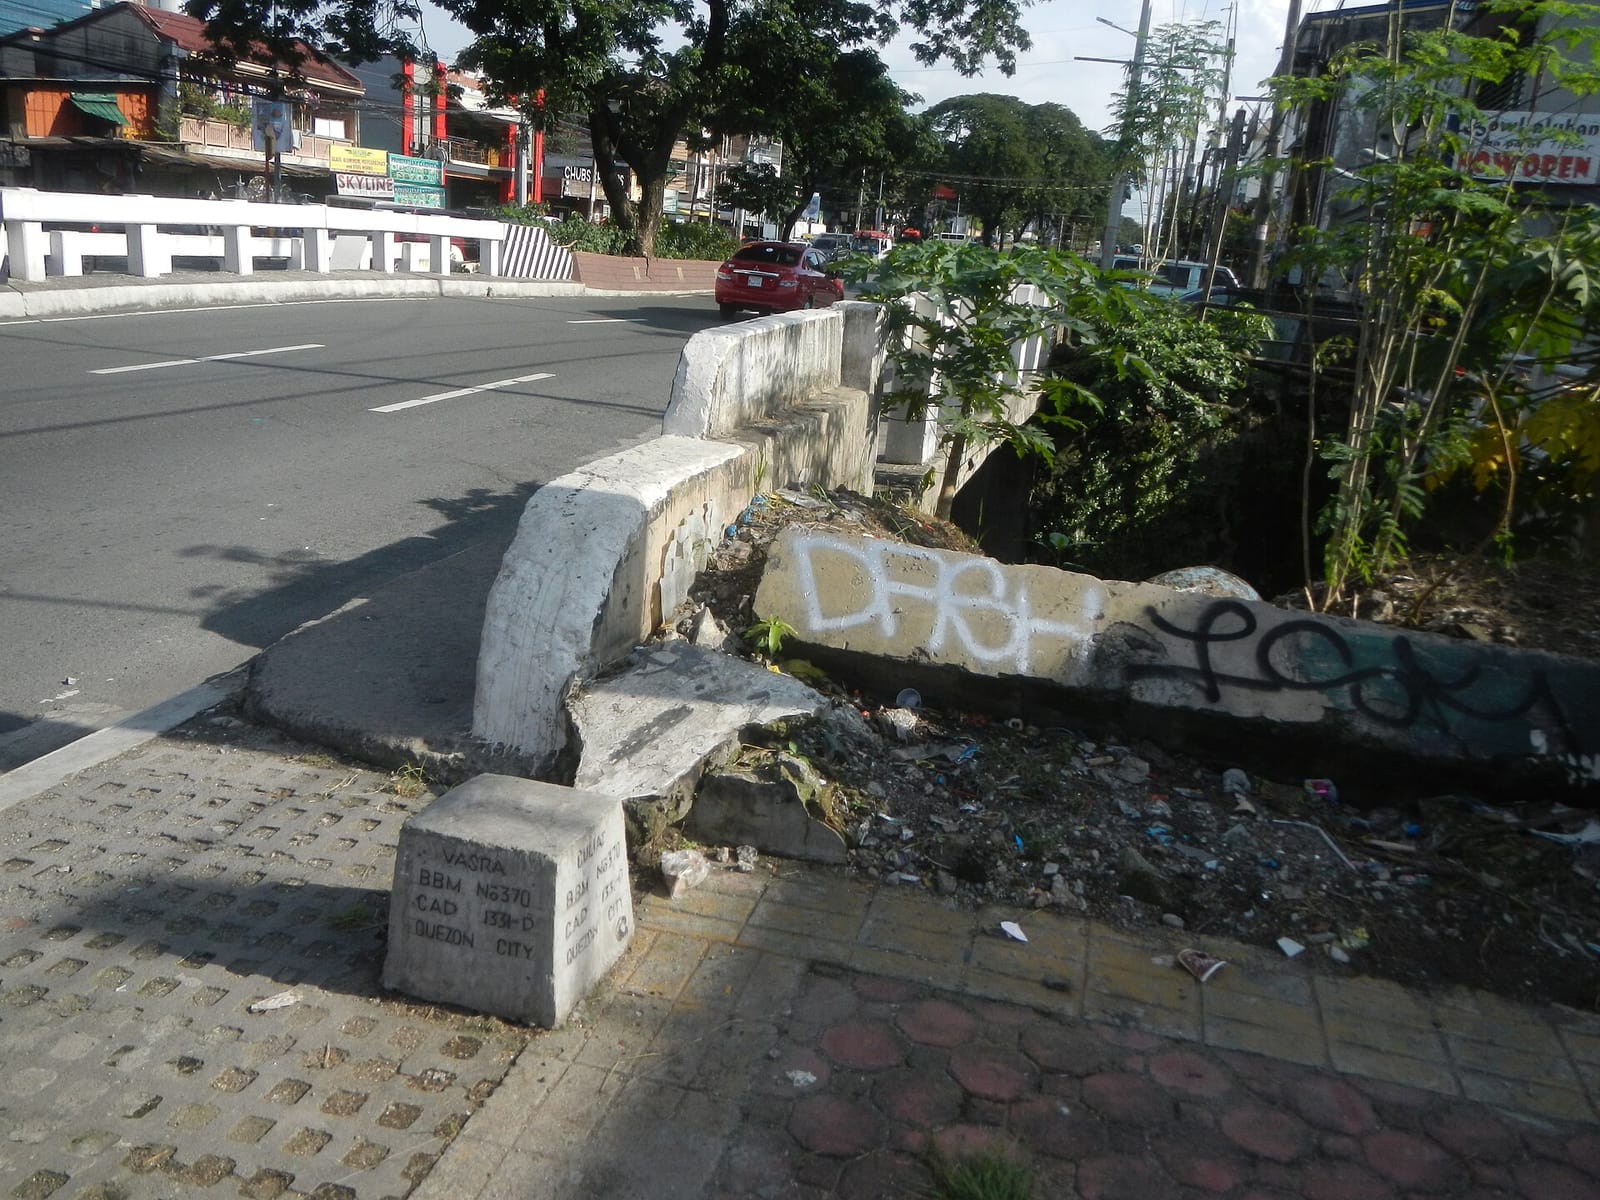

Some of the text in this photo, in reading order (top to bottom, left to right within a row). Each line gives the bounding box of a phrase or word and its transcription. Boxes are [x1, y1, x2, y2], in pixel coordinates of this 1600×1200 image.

[564, 166, 591, 182] CHUBS
[1522, 153, 1591, 178] OPEN
[338, 174, 393, 192] SKYLINE
[443, 848, 506, 876] VASRA
[419, 868, 462, 893] BBM
[416, 894, 458, 916] CAD
[566, 878, 589, 910] BBM
[565, 906, 588, 940] CAD
[415, 919, 533, 959] QUEZON CITY
